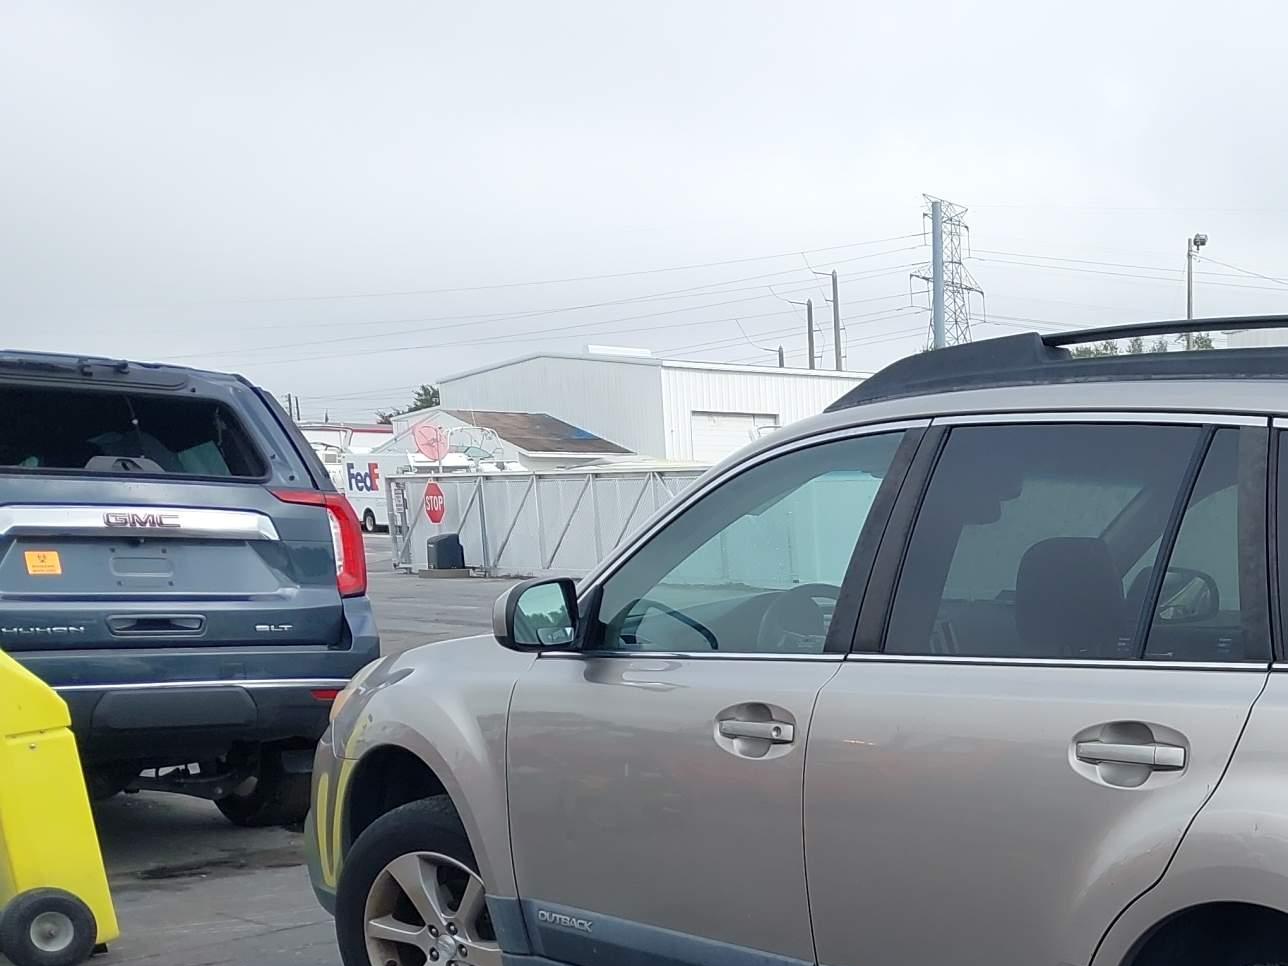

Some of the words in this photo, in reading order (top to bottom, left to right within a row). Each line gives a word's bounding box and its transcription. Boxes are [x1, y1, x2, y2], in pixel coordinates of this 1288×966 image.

[425, 495, 443, 511] STOP
[103, 512, 181, 528] GMC
[255, 624, 293, 632] SLT
[538, 910, 593, 933] OUTBACK
